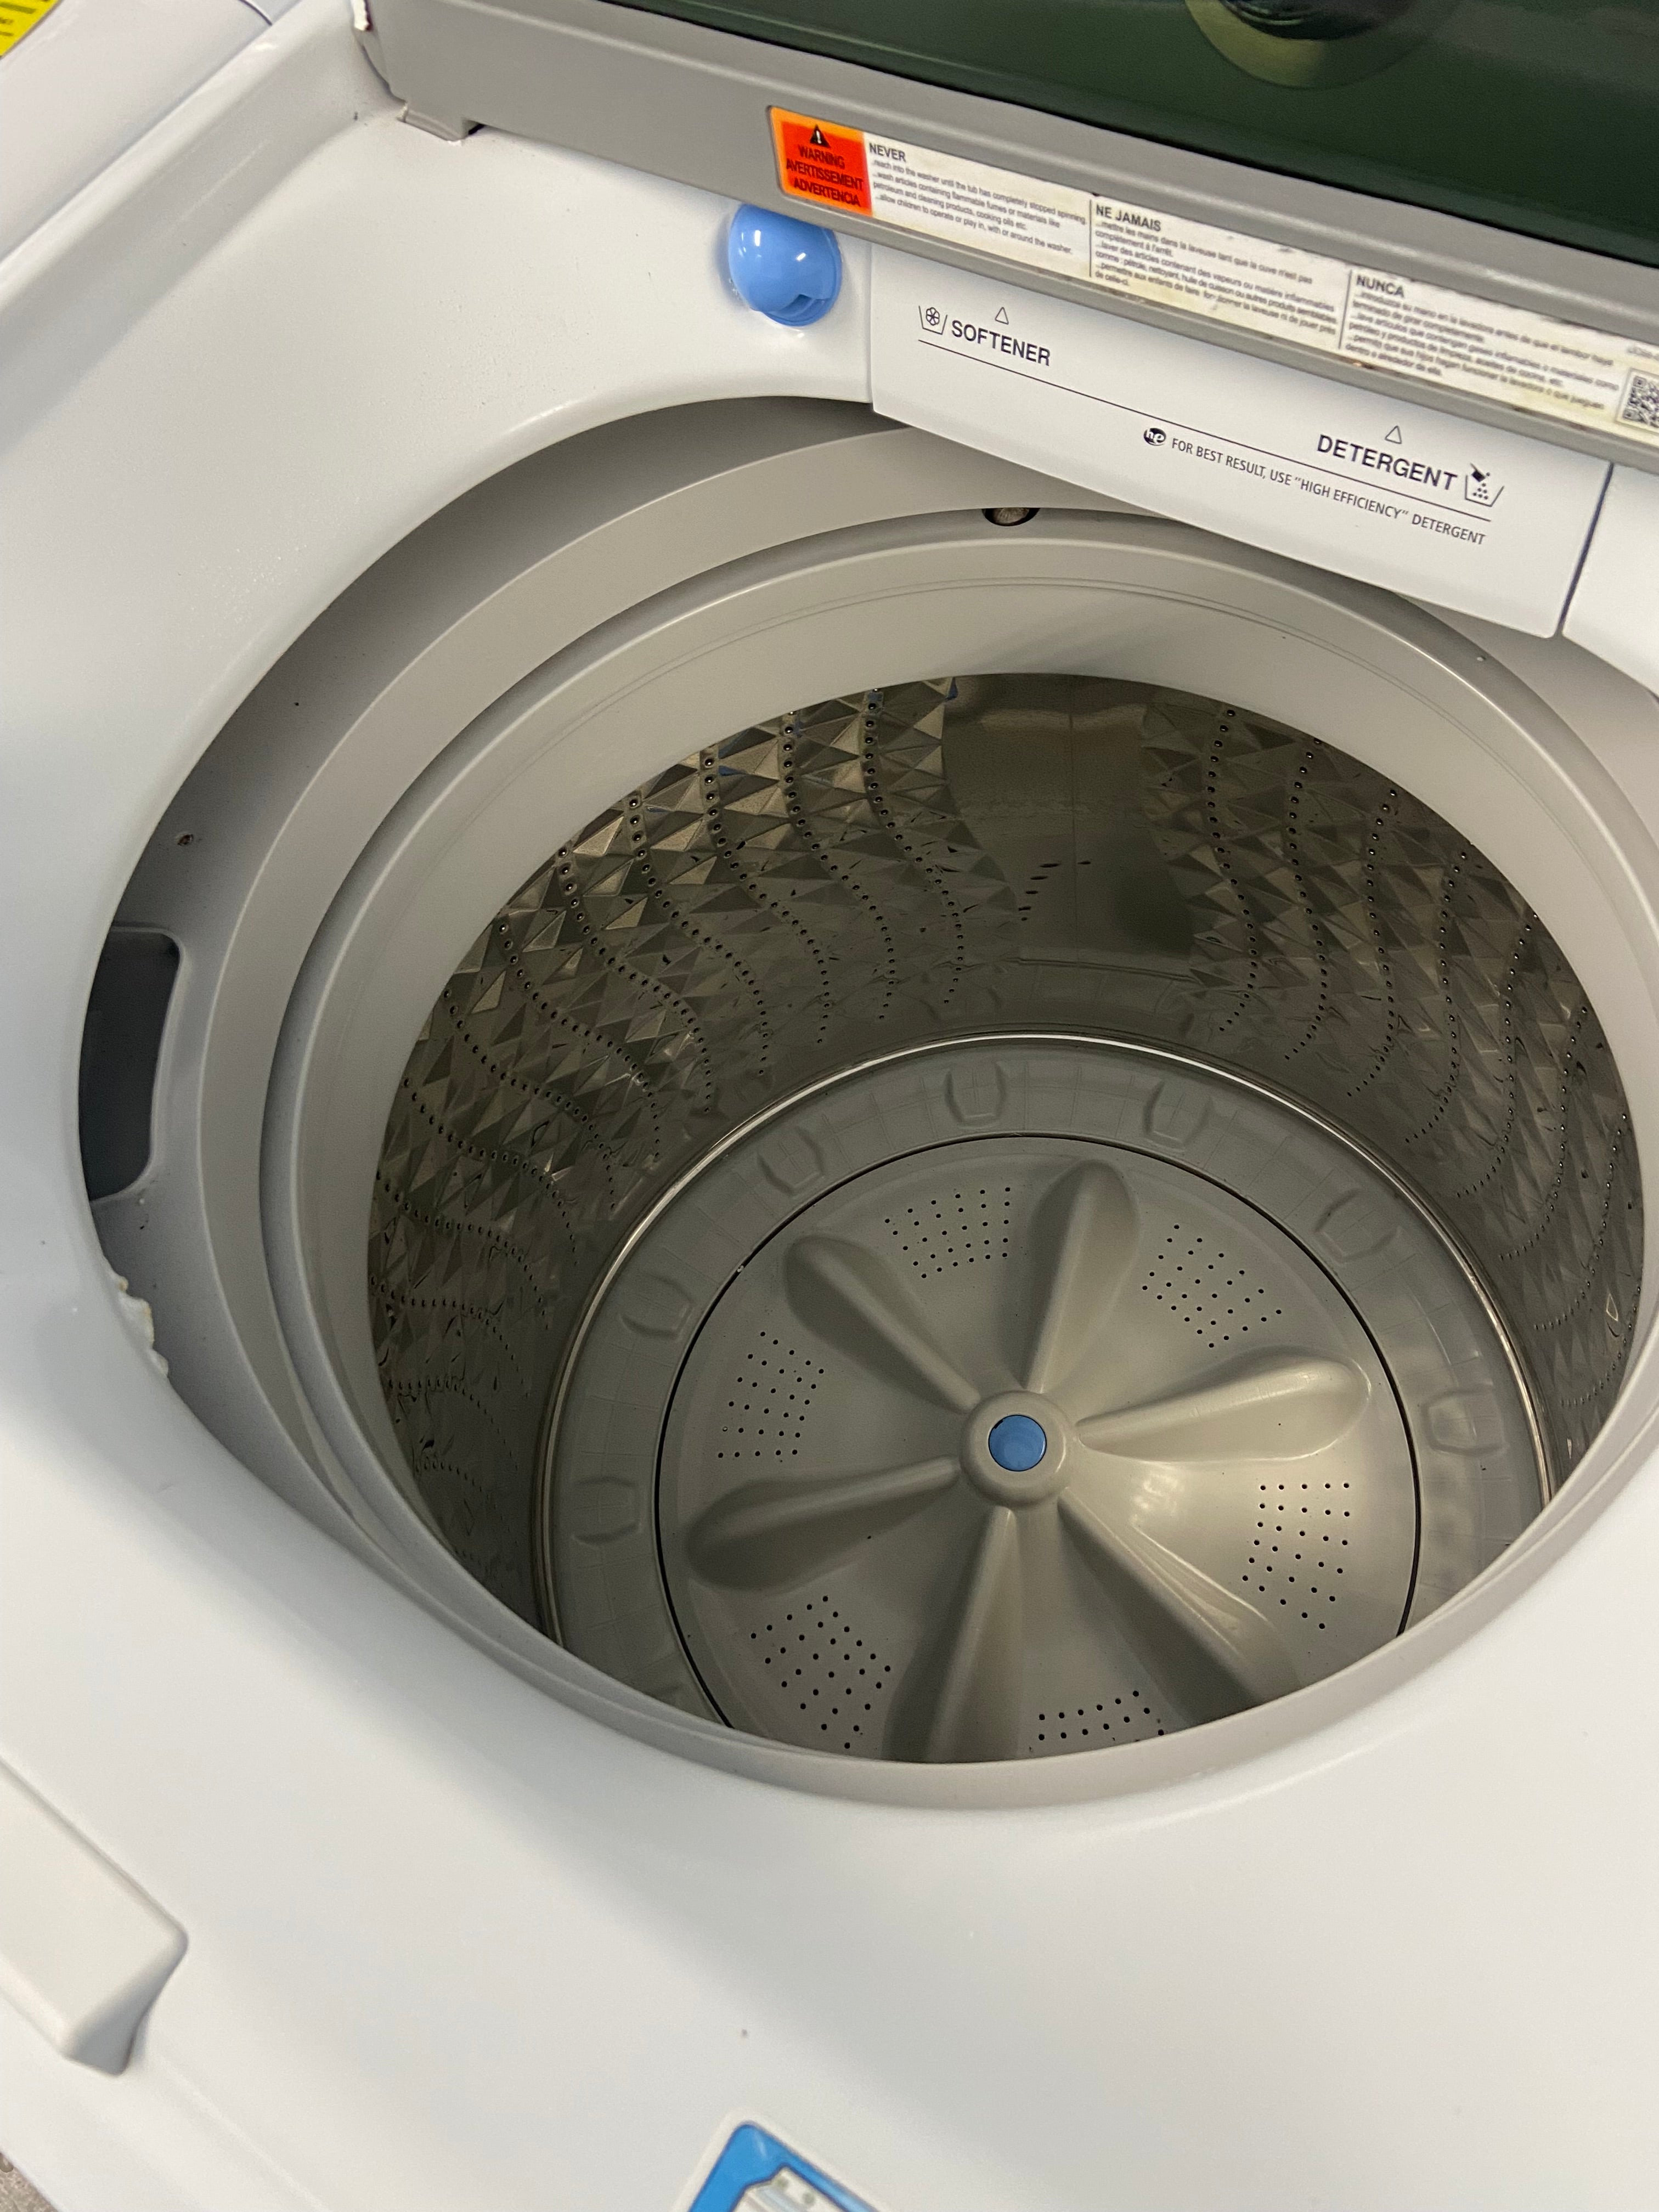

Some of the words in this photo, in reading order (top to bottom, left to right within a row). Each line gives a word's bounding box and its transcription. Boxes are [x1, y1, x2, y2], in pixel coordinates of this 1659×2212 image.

[798, 144, 845, 170] WARNING
[868, 142, 906, 162] NEVER
[786, 159, 864, 191] AVERTISSEMENT
[794, 178, 861, 207] ADVERTENCIA
[905, 167, 915, 176] the
[917, 171, 939, 183] washer
[941, 177, 954, 187] until
[955, 181, 966, 190] the
[967, 184, 977, 193] tub
[979, 188, 990, 197] has
[992, 191, 1027, 208] completely
[1029, 201, 1055, 216] stopped
[873, 182, 903, 196] petroleum
[905, 190, 916, 199] and
[918, 194, 944, 208] cleaning
[976, 210, 1001, 225] cooking
[1003, 217, 1013, 227] oils
[895, 176, 916, 188] articles
[918, 183, 950, 199] containing
[952, 191, 984, 207] flammable
[986, 200, 1006, 213] fumes
[1017, 210, 1047, 224] materials
[1048, 218, 1059, 228] like
[896, 198, 921, 211] children
[930, 208, 953, 221] operate
[963, 217, 976, 229] play
[988, 224, 1000, 234] with
[1010, 230, 1032, 244] around
[1035, 238, 1045, 246] the
[1096, 204, 1111, 218] NE
[1115, 208, 1161, 232] JAMAIS
[1120, 246, 1132, 256] des
[1161, 257, 1196, 274] contenant
[1198, 268, 1211, 278] des
[1243, 281, 1253, 290] ou
[1160, 236, 1178, 247] dans
[1188, 244, 1216, 258] laveuse
[1356, 274, 1405, 298] NUNCA
[952, 320, 1051, 366] SOFTENER
[1317, 435, 1458, 490] DETERGENT
[1172, 438, 1193, 455] FOR
[1196, 445, 1223, 464] BEST
[1226, 455, 1266, 479] RESULT,
[1270, 469, 1291, 486] USE
[1412, 514, 1486, 545] DETERGENT
